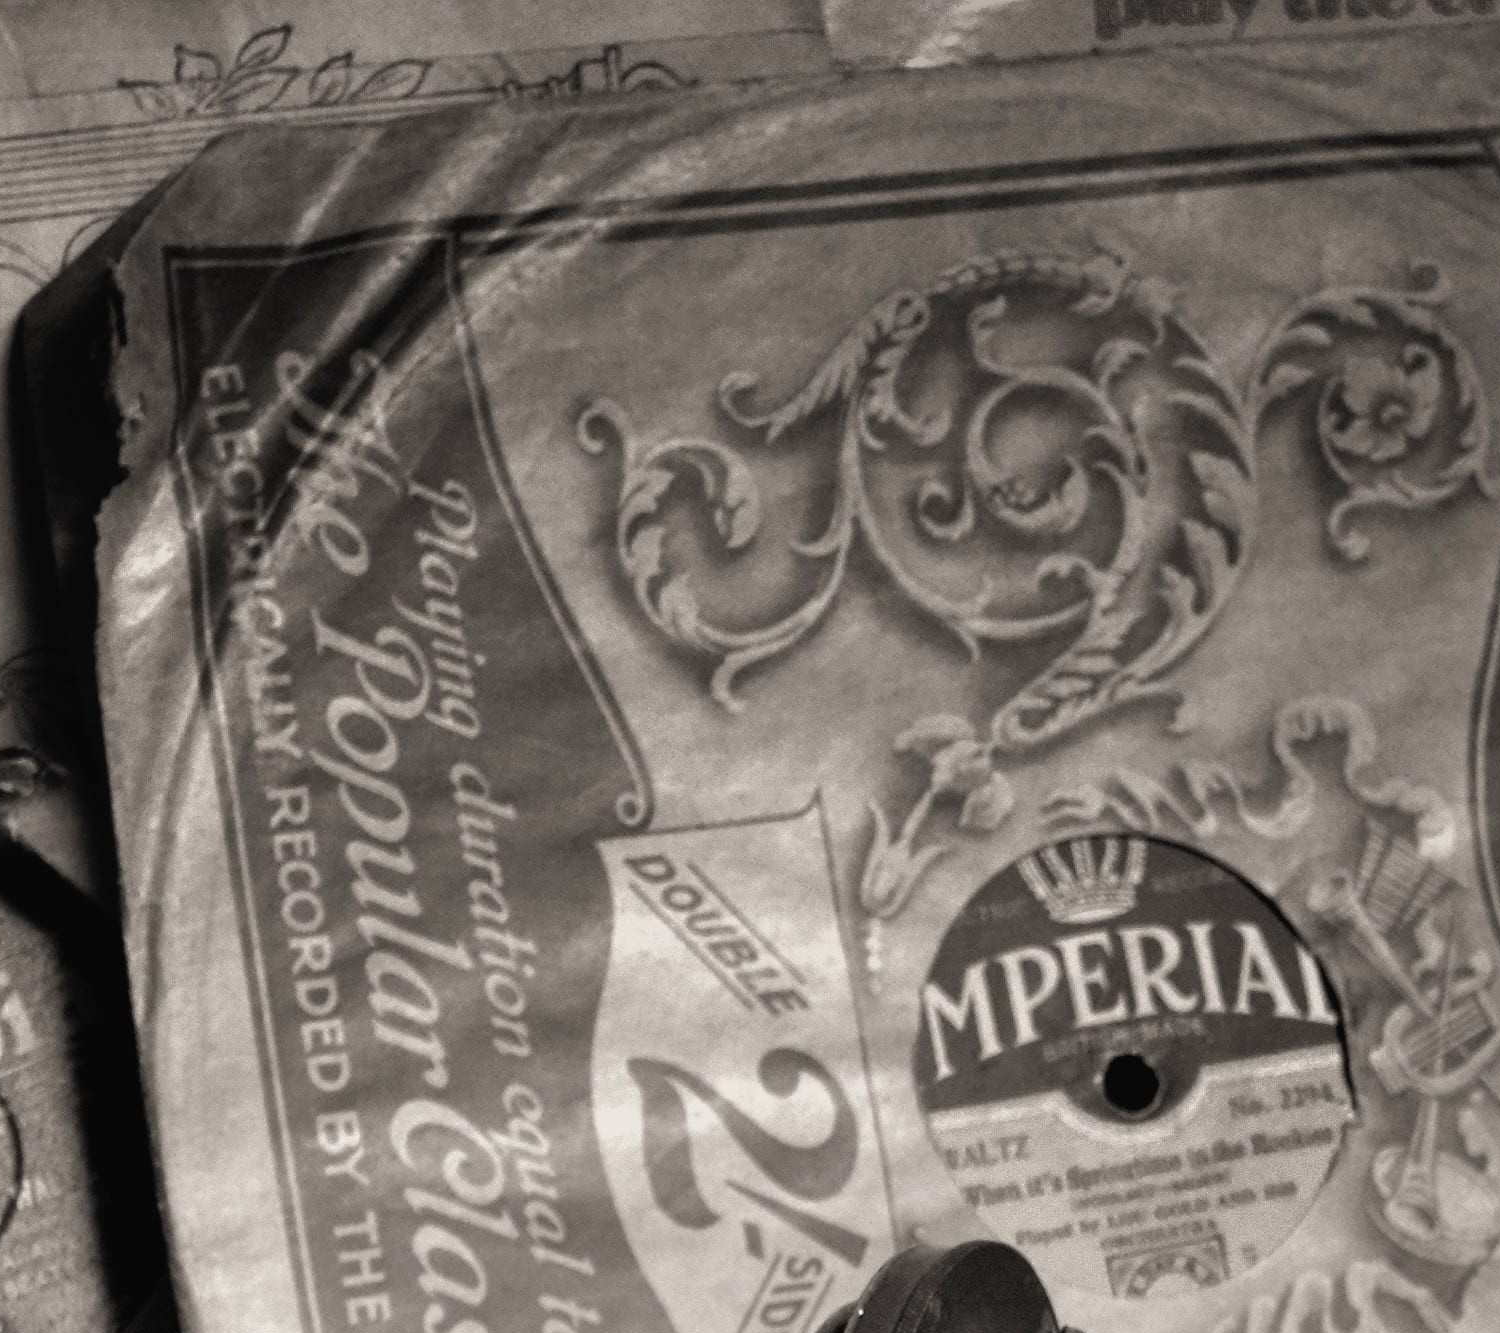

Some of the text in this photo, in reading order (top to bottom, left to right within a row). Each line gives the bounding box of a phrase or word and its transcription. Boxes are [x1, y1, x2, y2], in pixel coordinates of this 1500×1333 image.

[200, 363, 301, 760] ELECTRICALLY
[265, 786, 352, 1093] RECORDED
[309, 604, 477, 1090] Popular
[391, 478, 484, 739] Playing
[450, 763, 540, 1059] duration
[495, 1083, 594, 1276] equal
[624, 851, 815, 1017] DOUBLE
[315, 1111, 370, 1187] BY
[332, 1210, 393, 1327] THE
